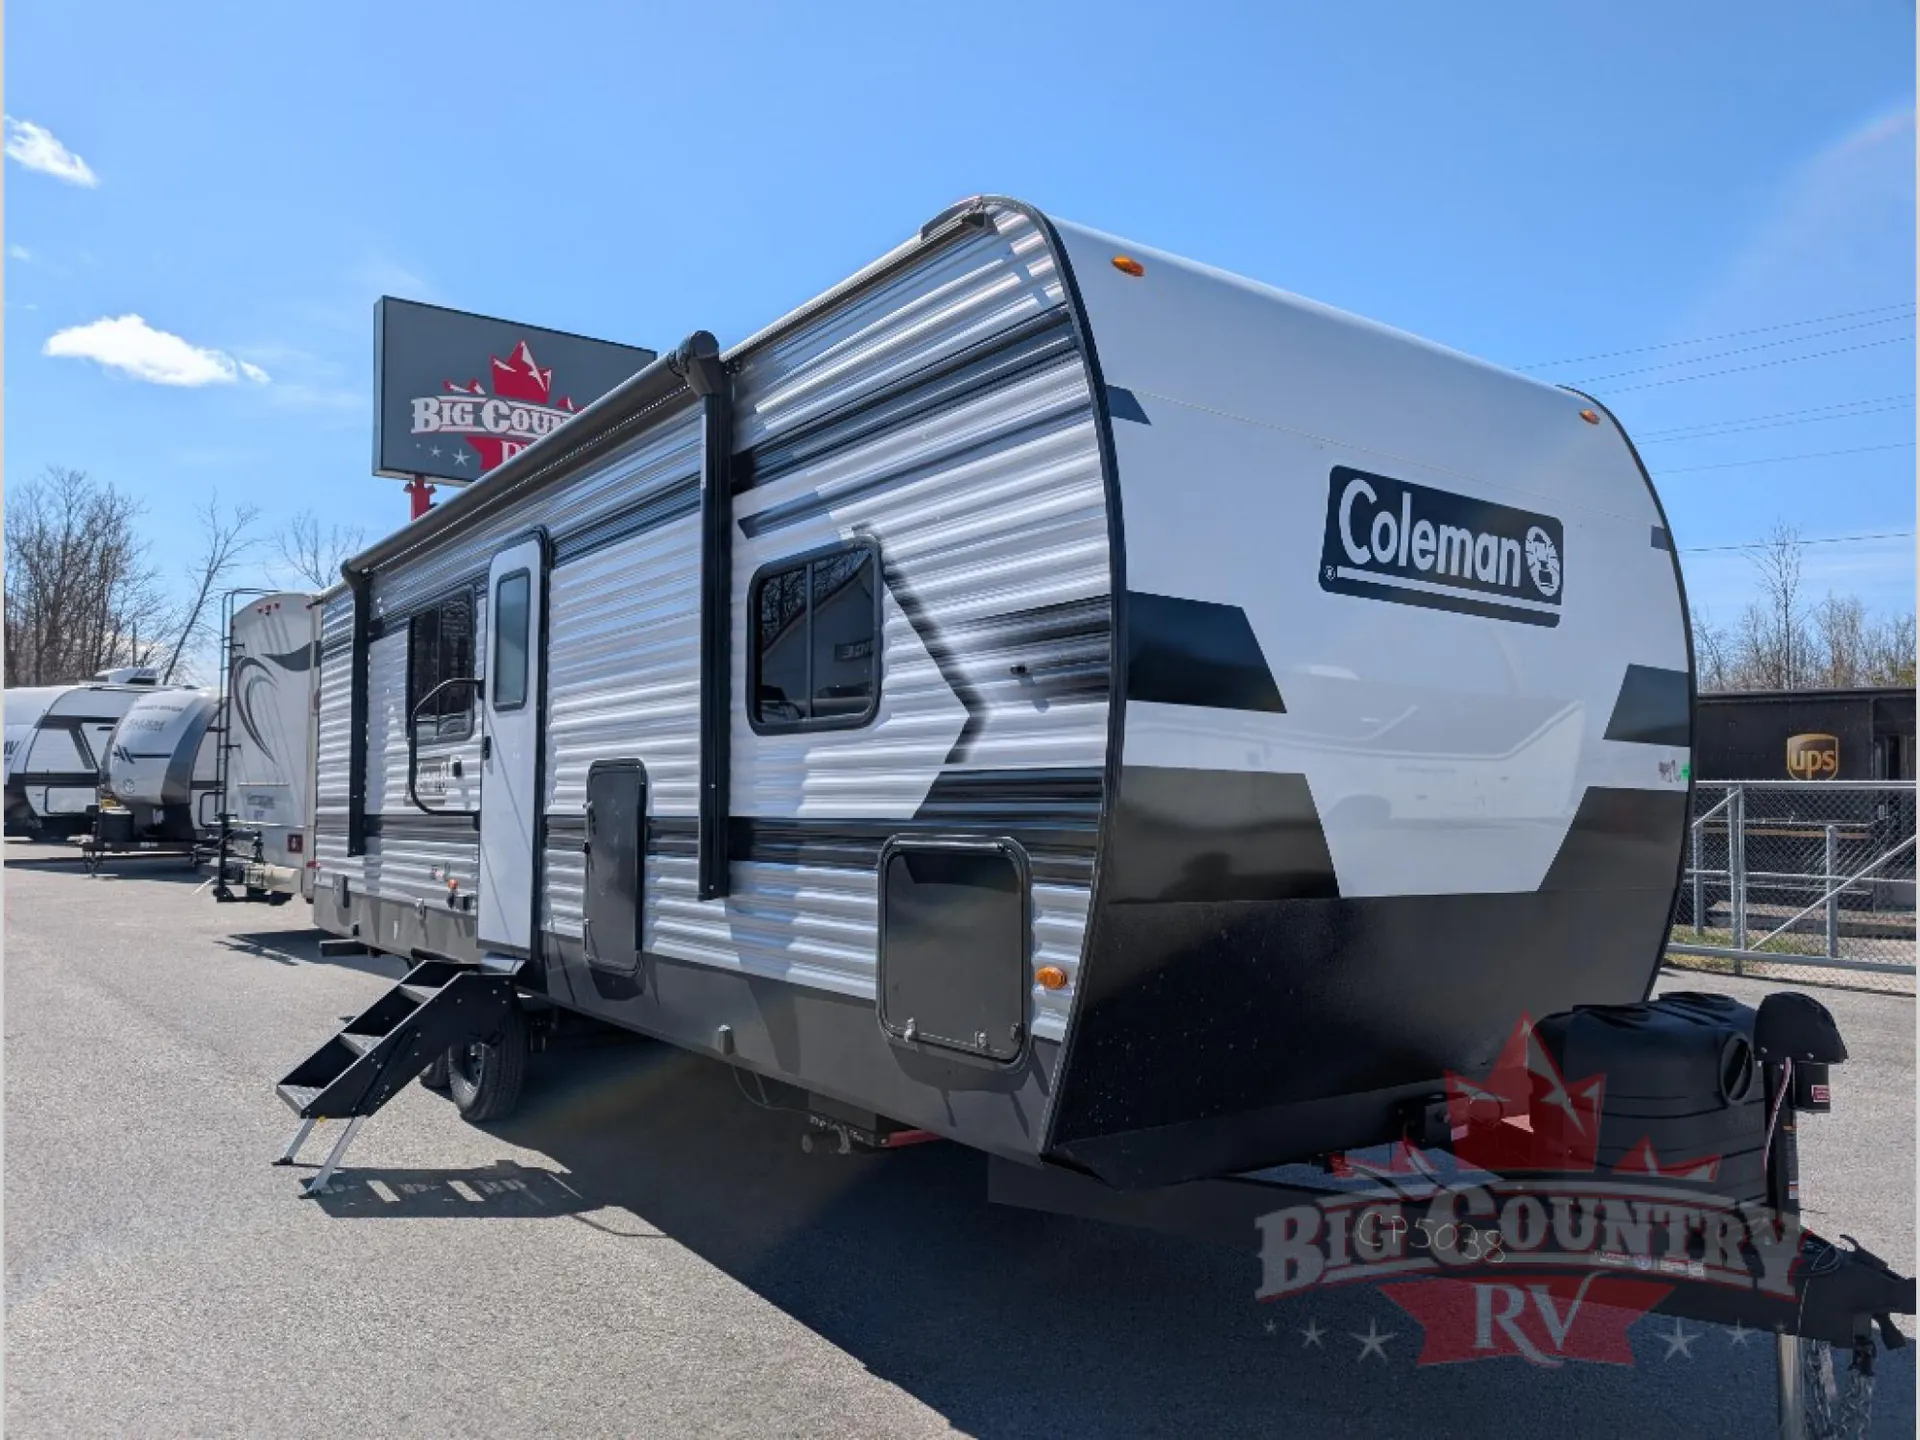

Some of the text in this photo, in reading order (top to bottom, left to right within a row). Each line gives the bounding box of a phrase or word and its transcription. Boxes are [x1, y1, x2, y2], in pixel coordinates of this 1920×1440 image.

[411, 397, 475, 434] BIG
[1338, 477, 1522, 588] Coleman
[1792, 750, 1836, 779] ups
